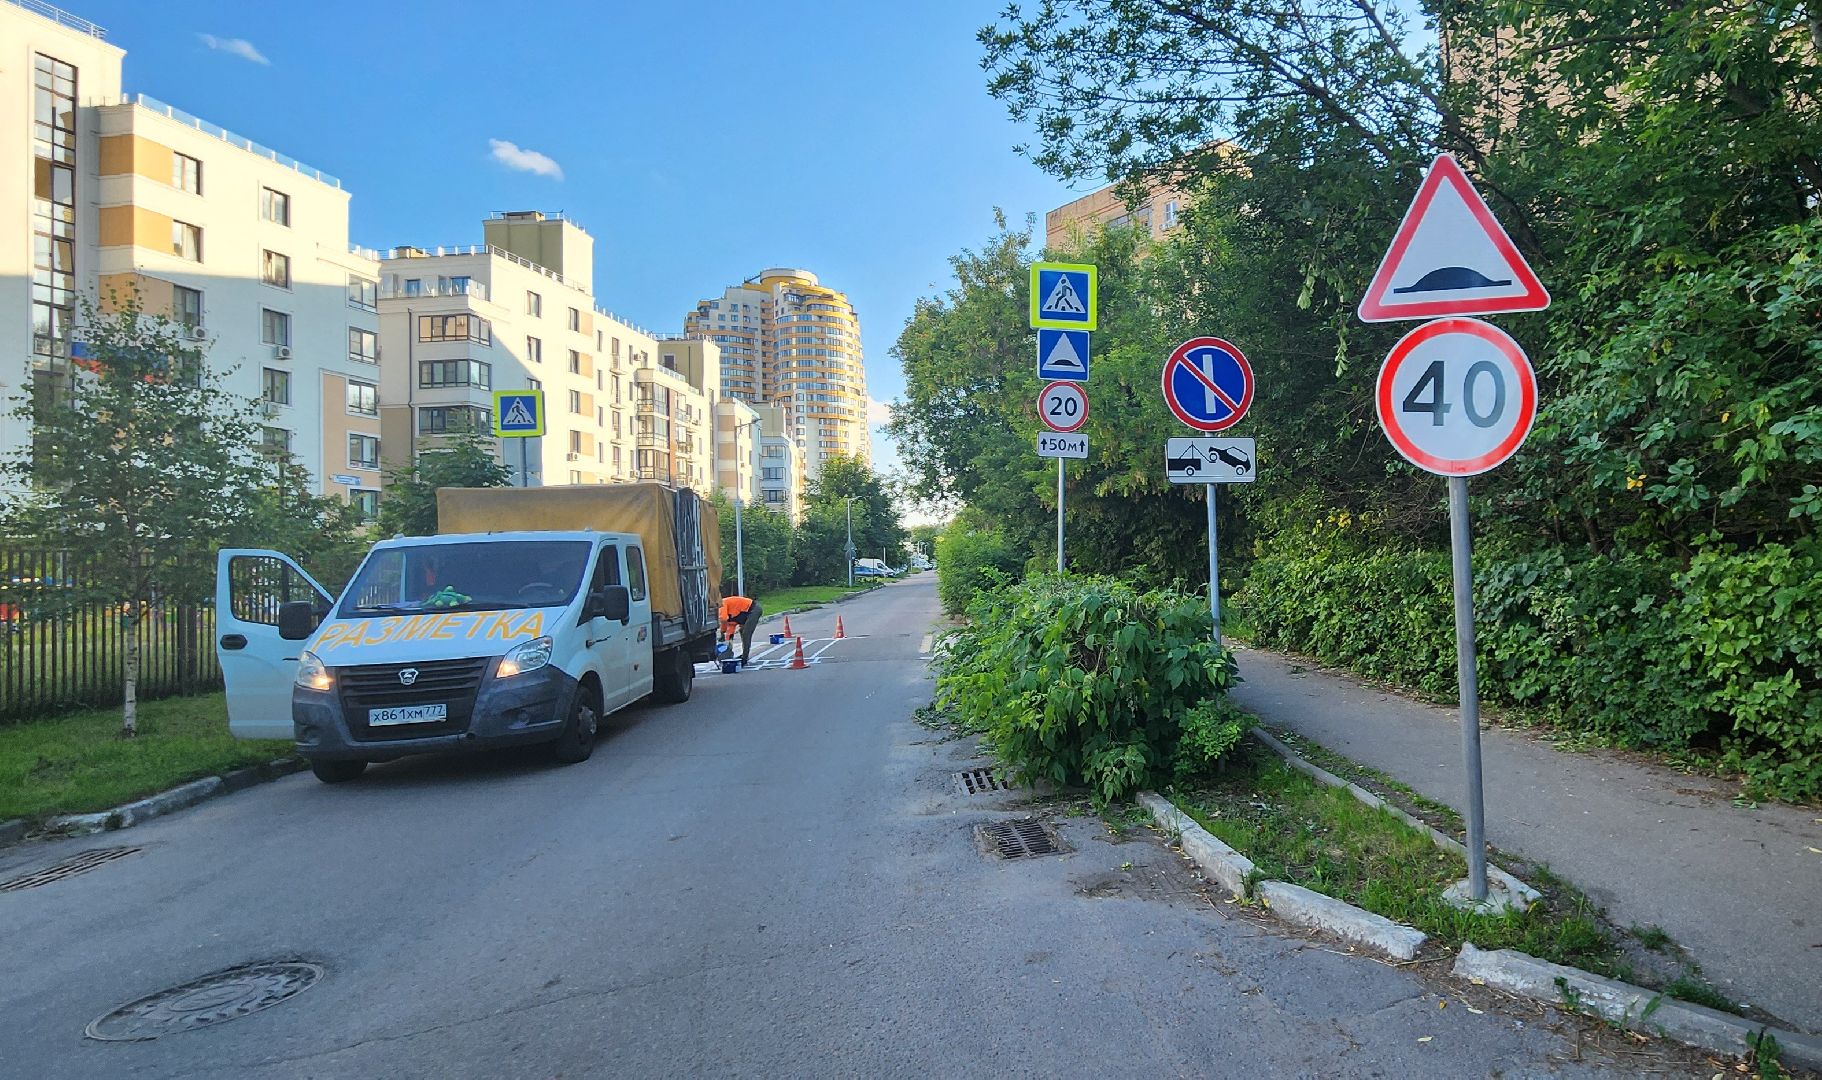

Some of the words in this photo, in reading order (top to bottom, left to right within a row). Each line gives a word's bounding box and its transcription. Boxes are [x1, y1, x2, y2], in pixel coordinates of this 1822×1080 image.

[1050, 396, 1078, 417] 20
[1403, 360, 1506, 428] 40
[311, 611, 546, 652] РАЗМЕТКА
